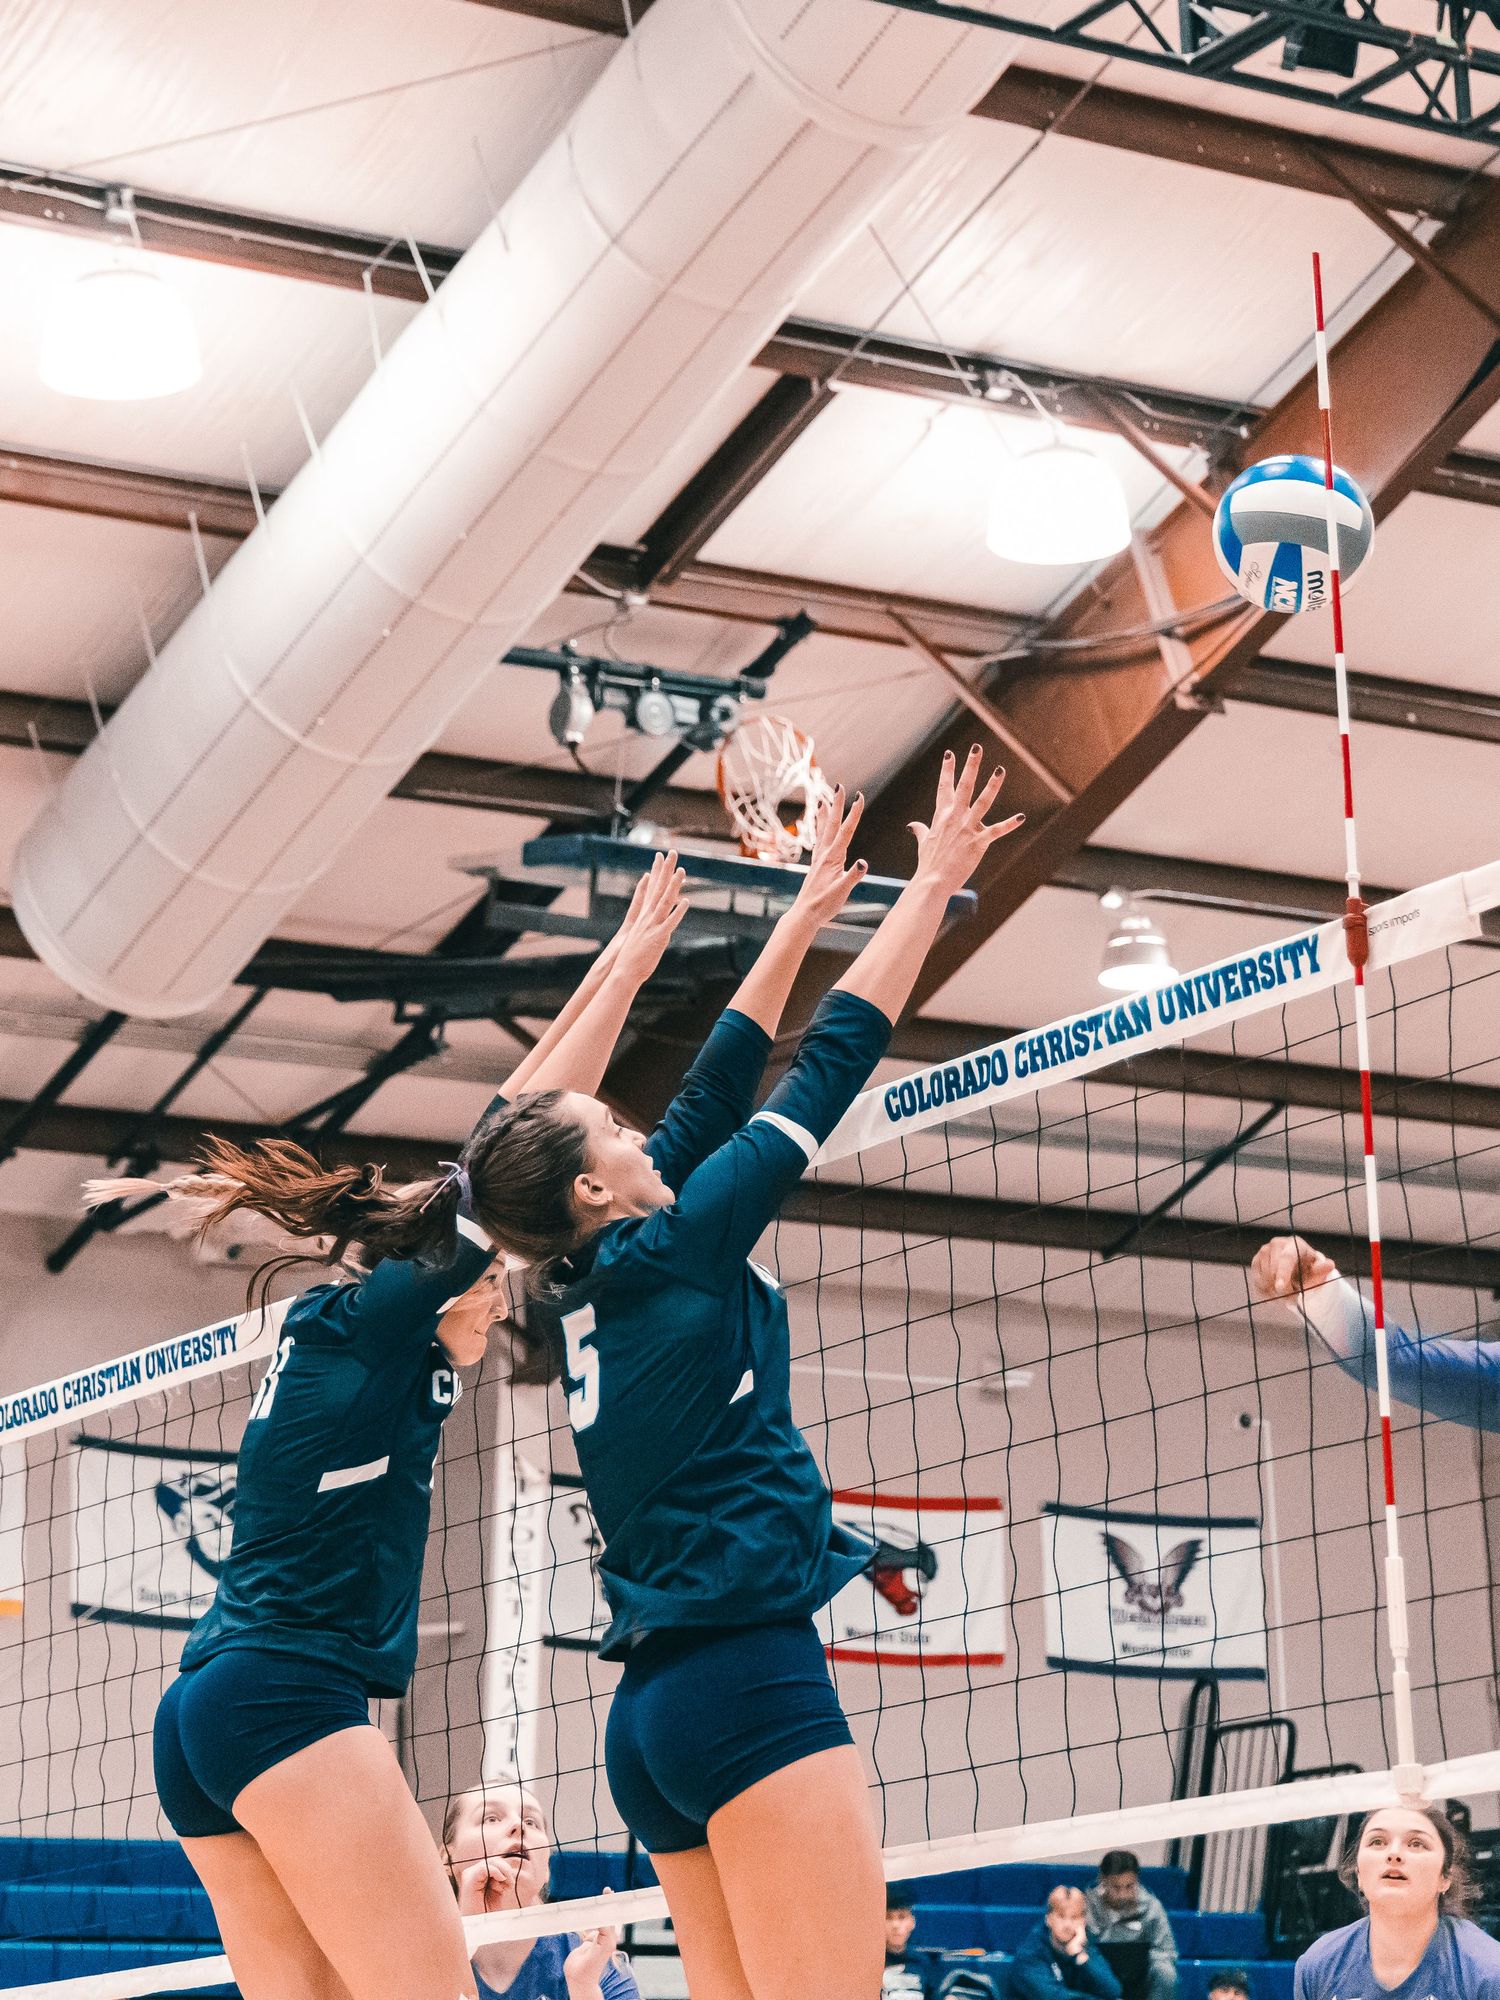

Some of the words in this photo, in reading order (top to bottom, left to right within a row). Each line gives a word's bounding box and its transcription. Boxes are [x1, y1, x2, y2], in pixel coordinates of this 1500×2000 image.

[884, 1052, 1009, 1122] COLORADO
[1014, 995, 1152, 1078] CHRISTIAN
[1156, 933, 1321, 1025] UNIVERSITY
[63, 1356, 141, 1410] CHRISTIAN
[145, 1323, 238, 1380] UNIVERSITY
[561, 1302, 600, 1433] 5
